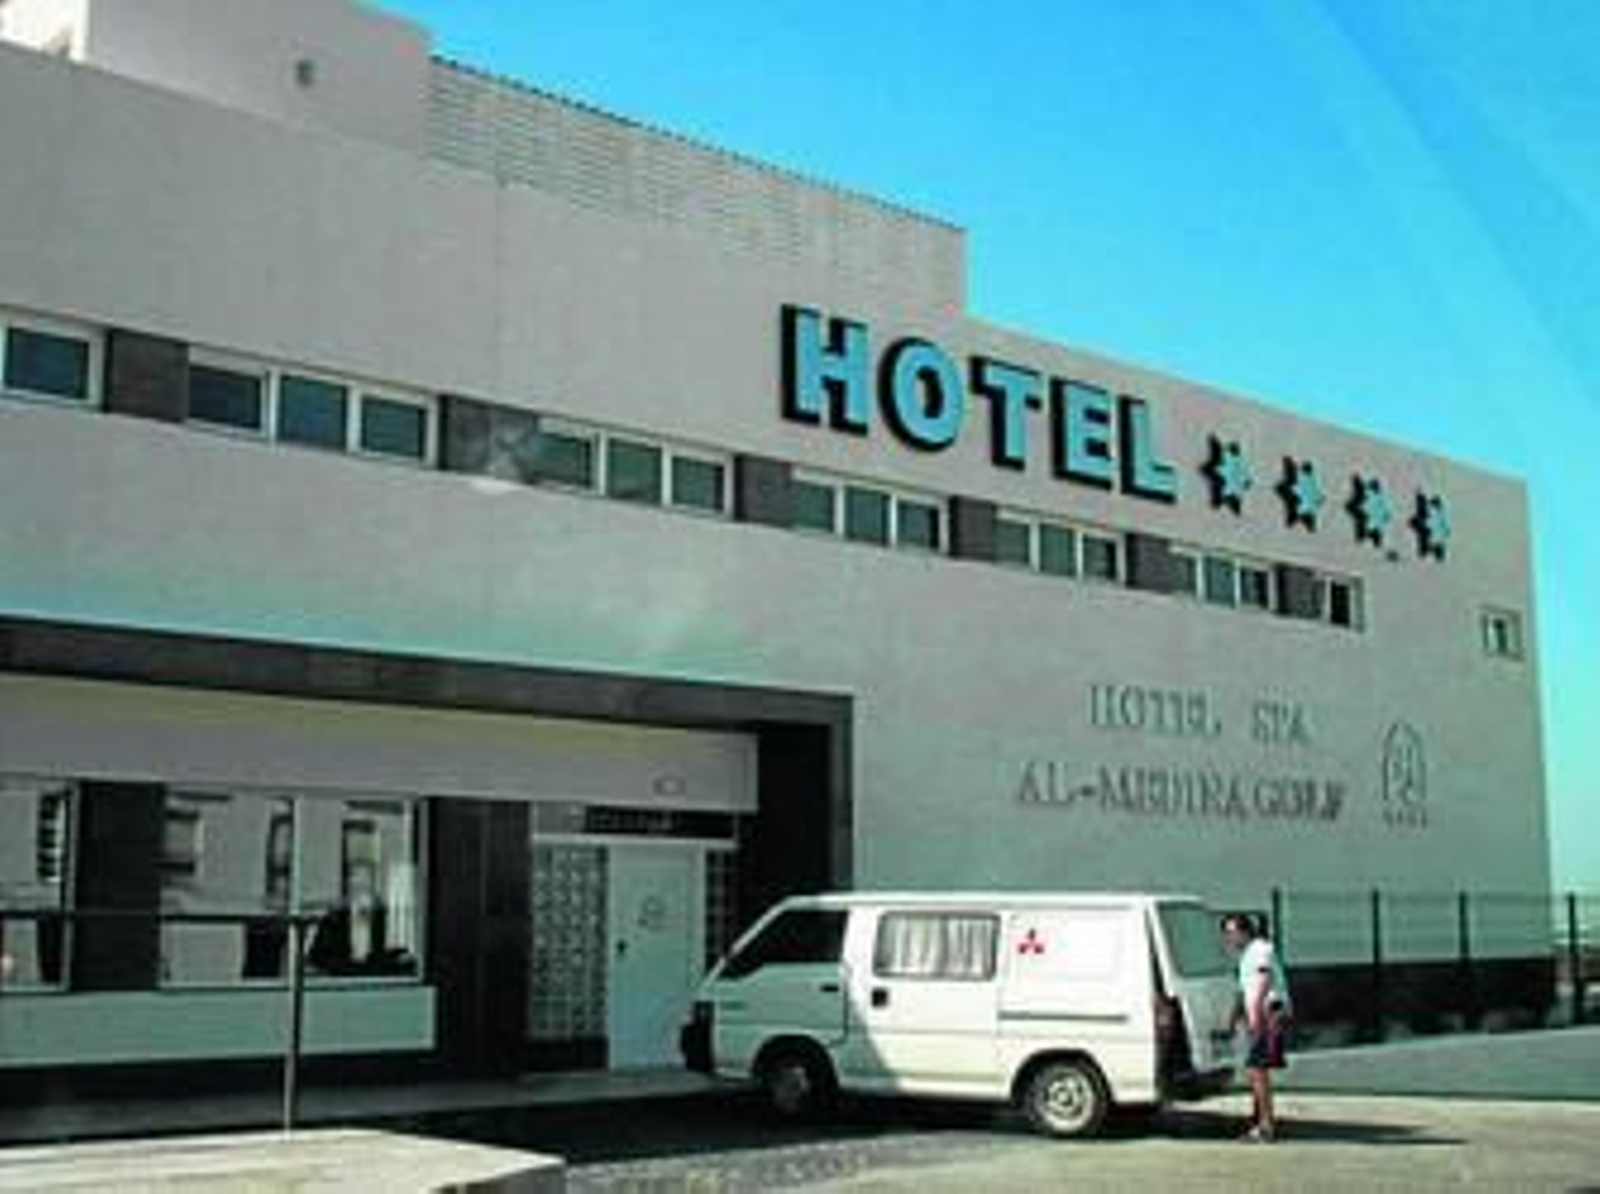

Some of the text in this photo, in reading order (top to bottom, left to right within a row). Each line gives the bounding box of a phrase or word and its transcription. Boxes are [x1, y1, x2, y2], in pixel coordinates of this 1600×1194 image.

[780, 302, 1178, 504] HOTEL
[1089, 684, 1312, 744] HOTEL SPA
